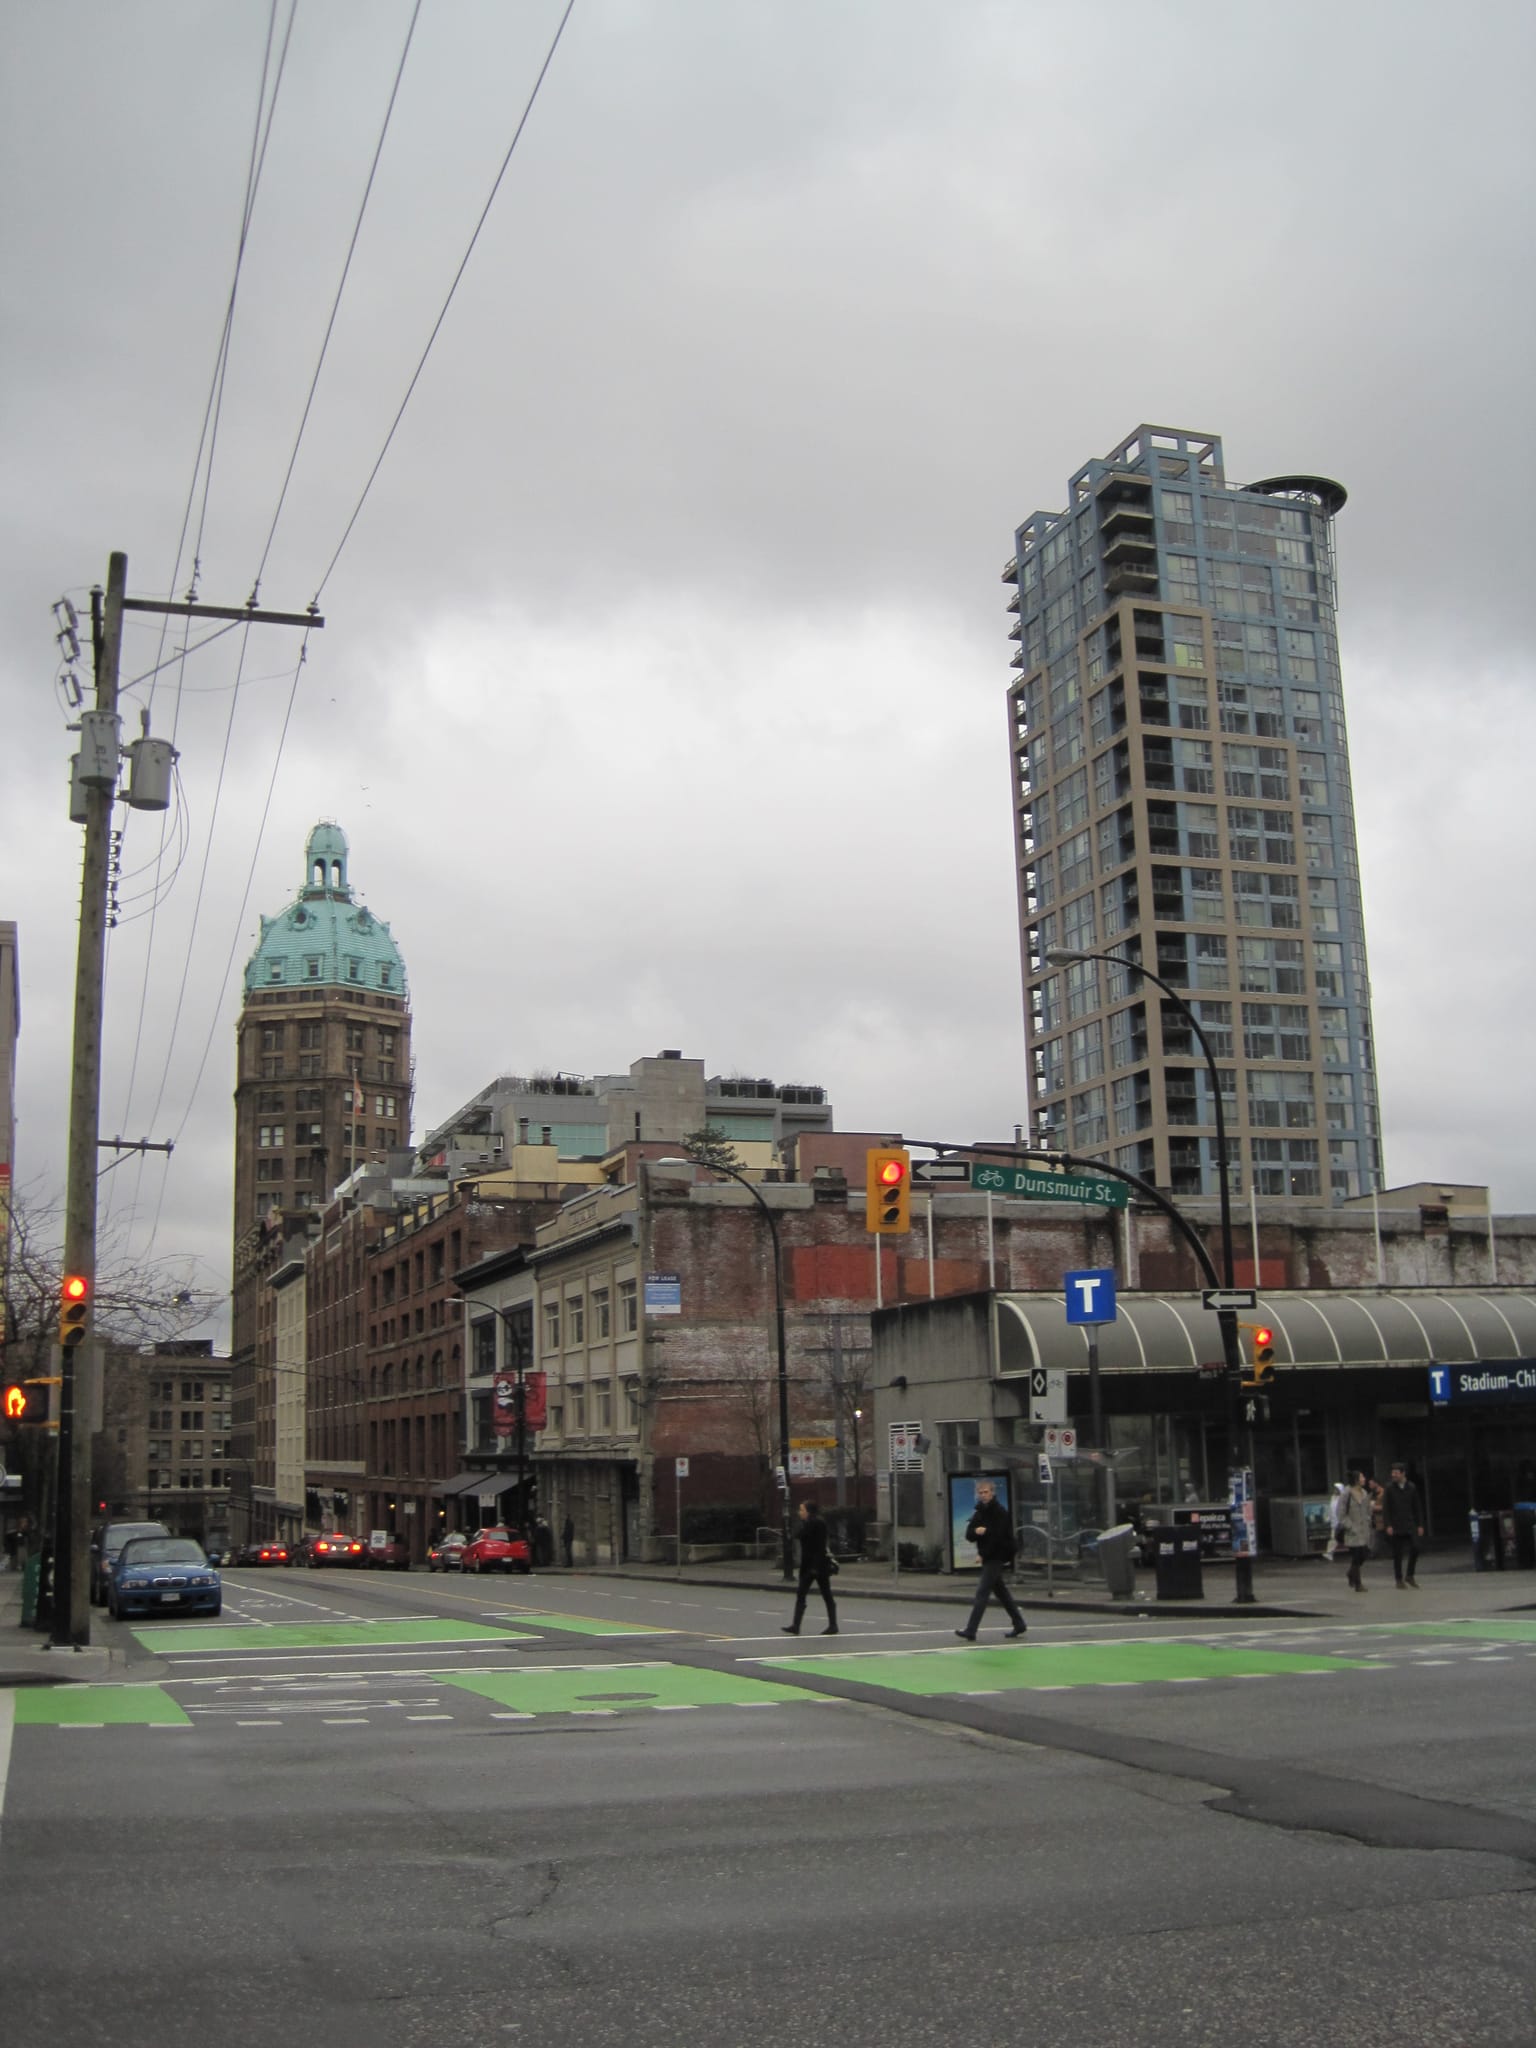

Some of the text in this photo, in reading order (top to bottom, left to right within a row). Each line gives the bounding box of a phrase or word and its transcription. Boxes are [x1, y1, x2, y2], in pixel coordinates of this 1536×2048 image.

[1014, 1173, 1117, 1203] Dunsmuir St.
[1074, 1278, 1101, 1313] T
[1431, 1370, 1445, 1395] T
